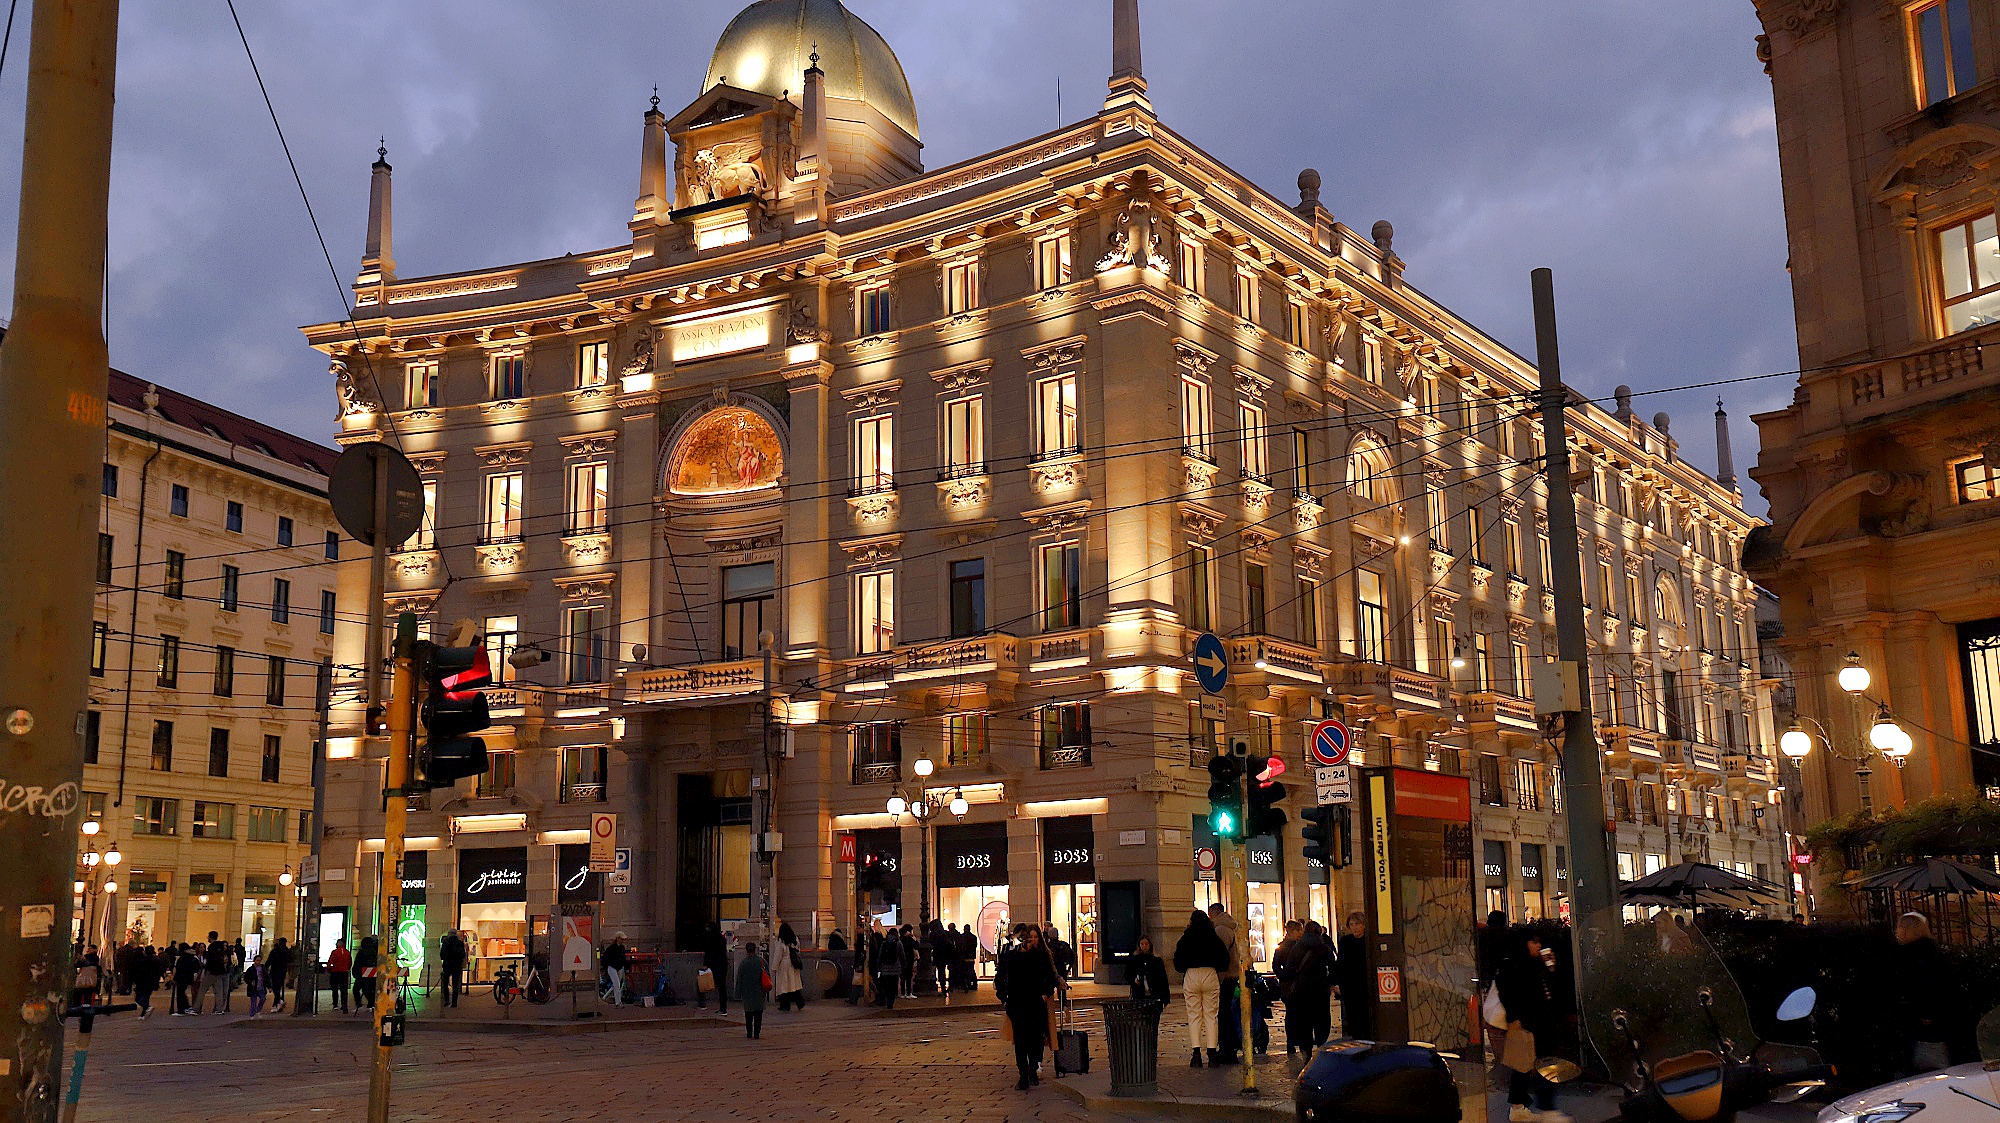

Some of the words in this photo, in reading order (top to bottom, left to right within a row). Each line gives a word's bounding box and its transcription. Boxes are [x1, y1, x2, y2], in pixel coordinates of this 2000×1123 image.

[1332, 770, 1346, 779] 24
[841, 840, 855, 857] M
[1053, 848, 1089, 864] BOSS
[956, 853, 991, 869] BOSS
[1378, 858, 1387, 892] VOLTA
